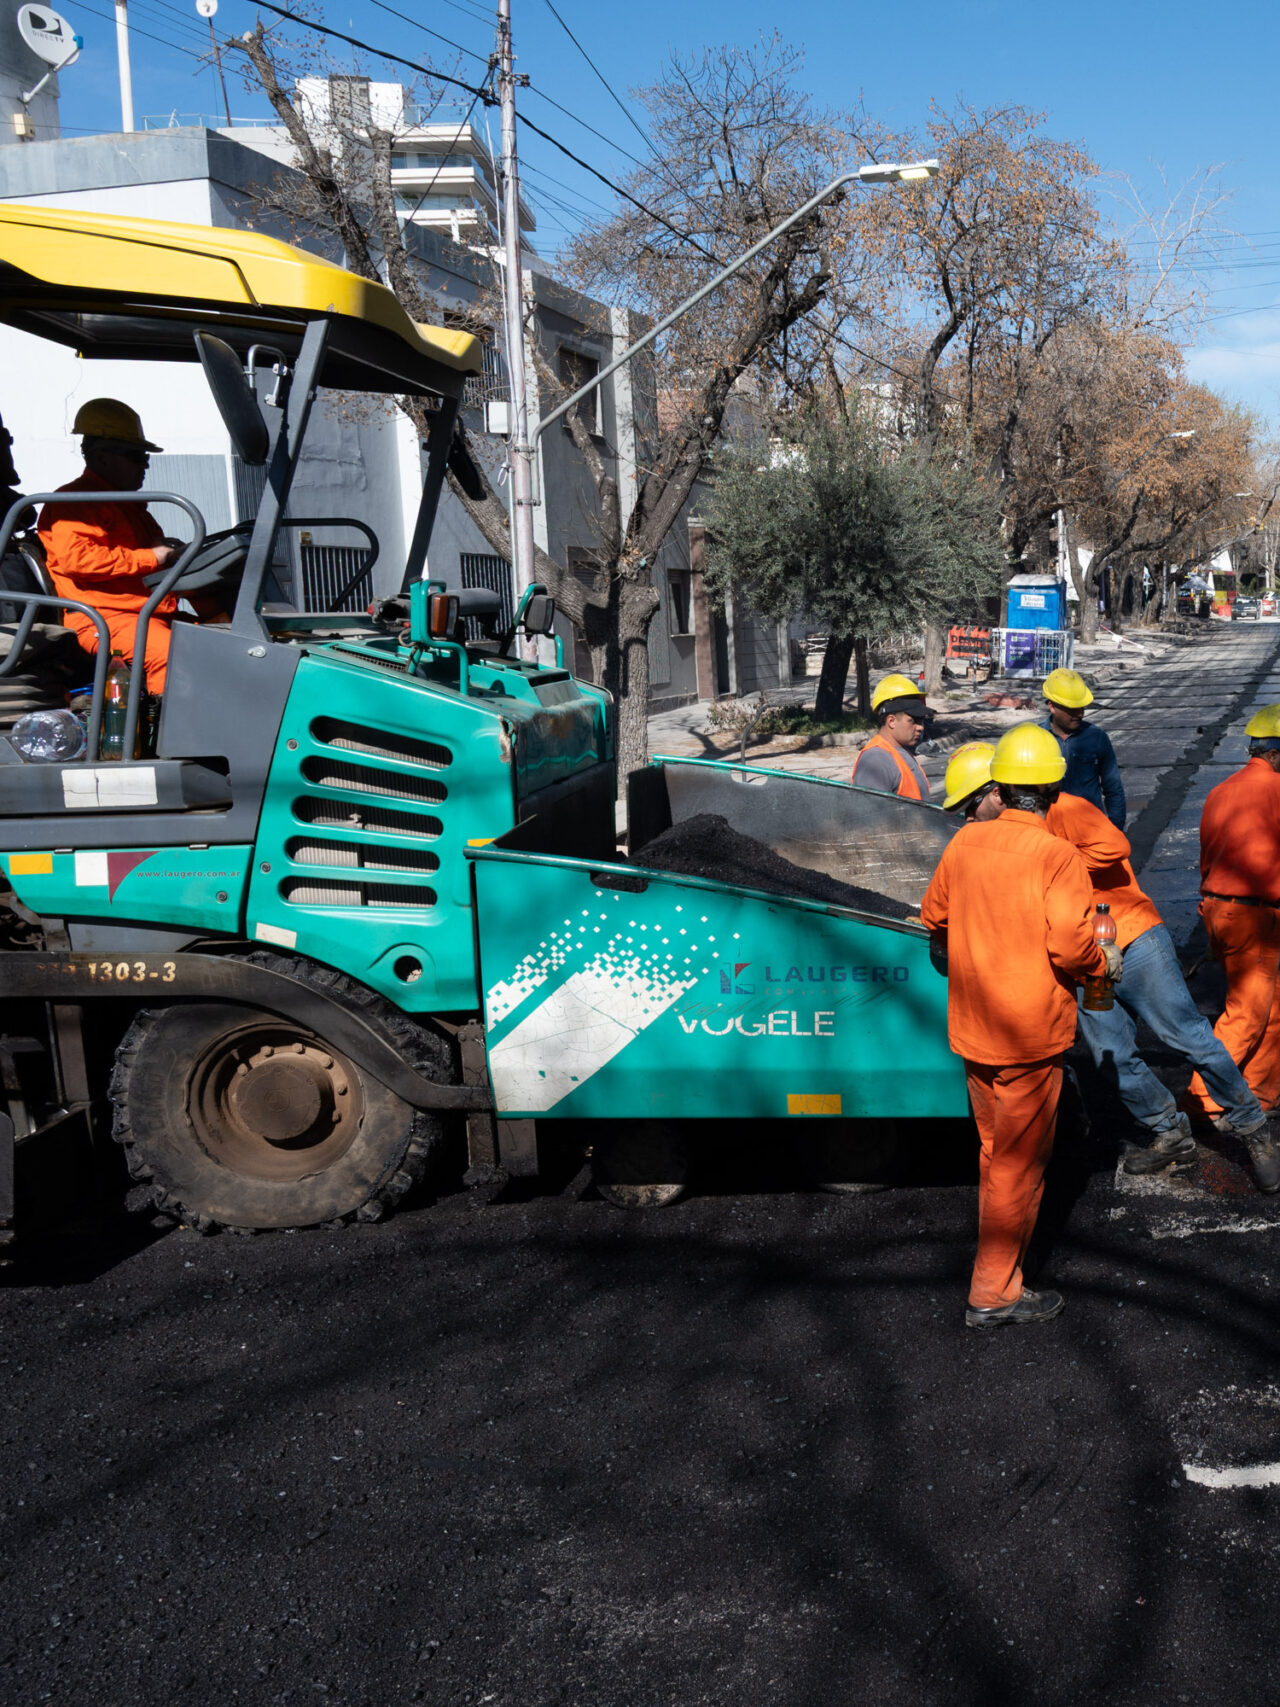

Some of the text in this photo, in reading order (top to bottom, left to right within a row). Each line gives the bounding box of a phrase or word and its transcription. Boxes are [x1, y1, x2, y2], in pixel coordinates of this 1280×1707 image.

[33, 30, 64, 43] DIRECTV
[136, 870, 240, 879] www.laugero.com.ar
[88, 962, 177, 983] 1303-3
[765, 966, 909, 983] LAUGERO
